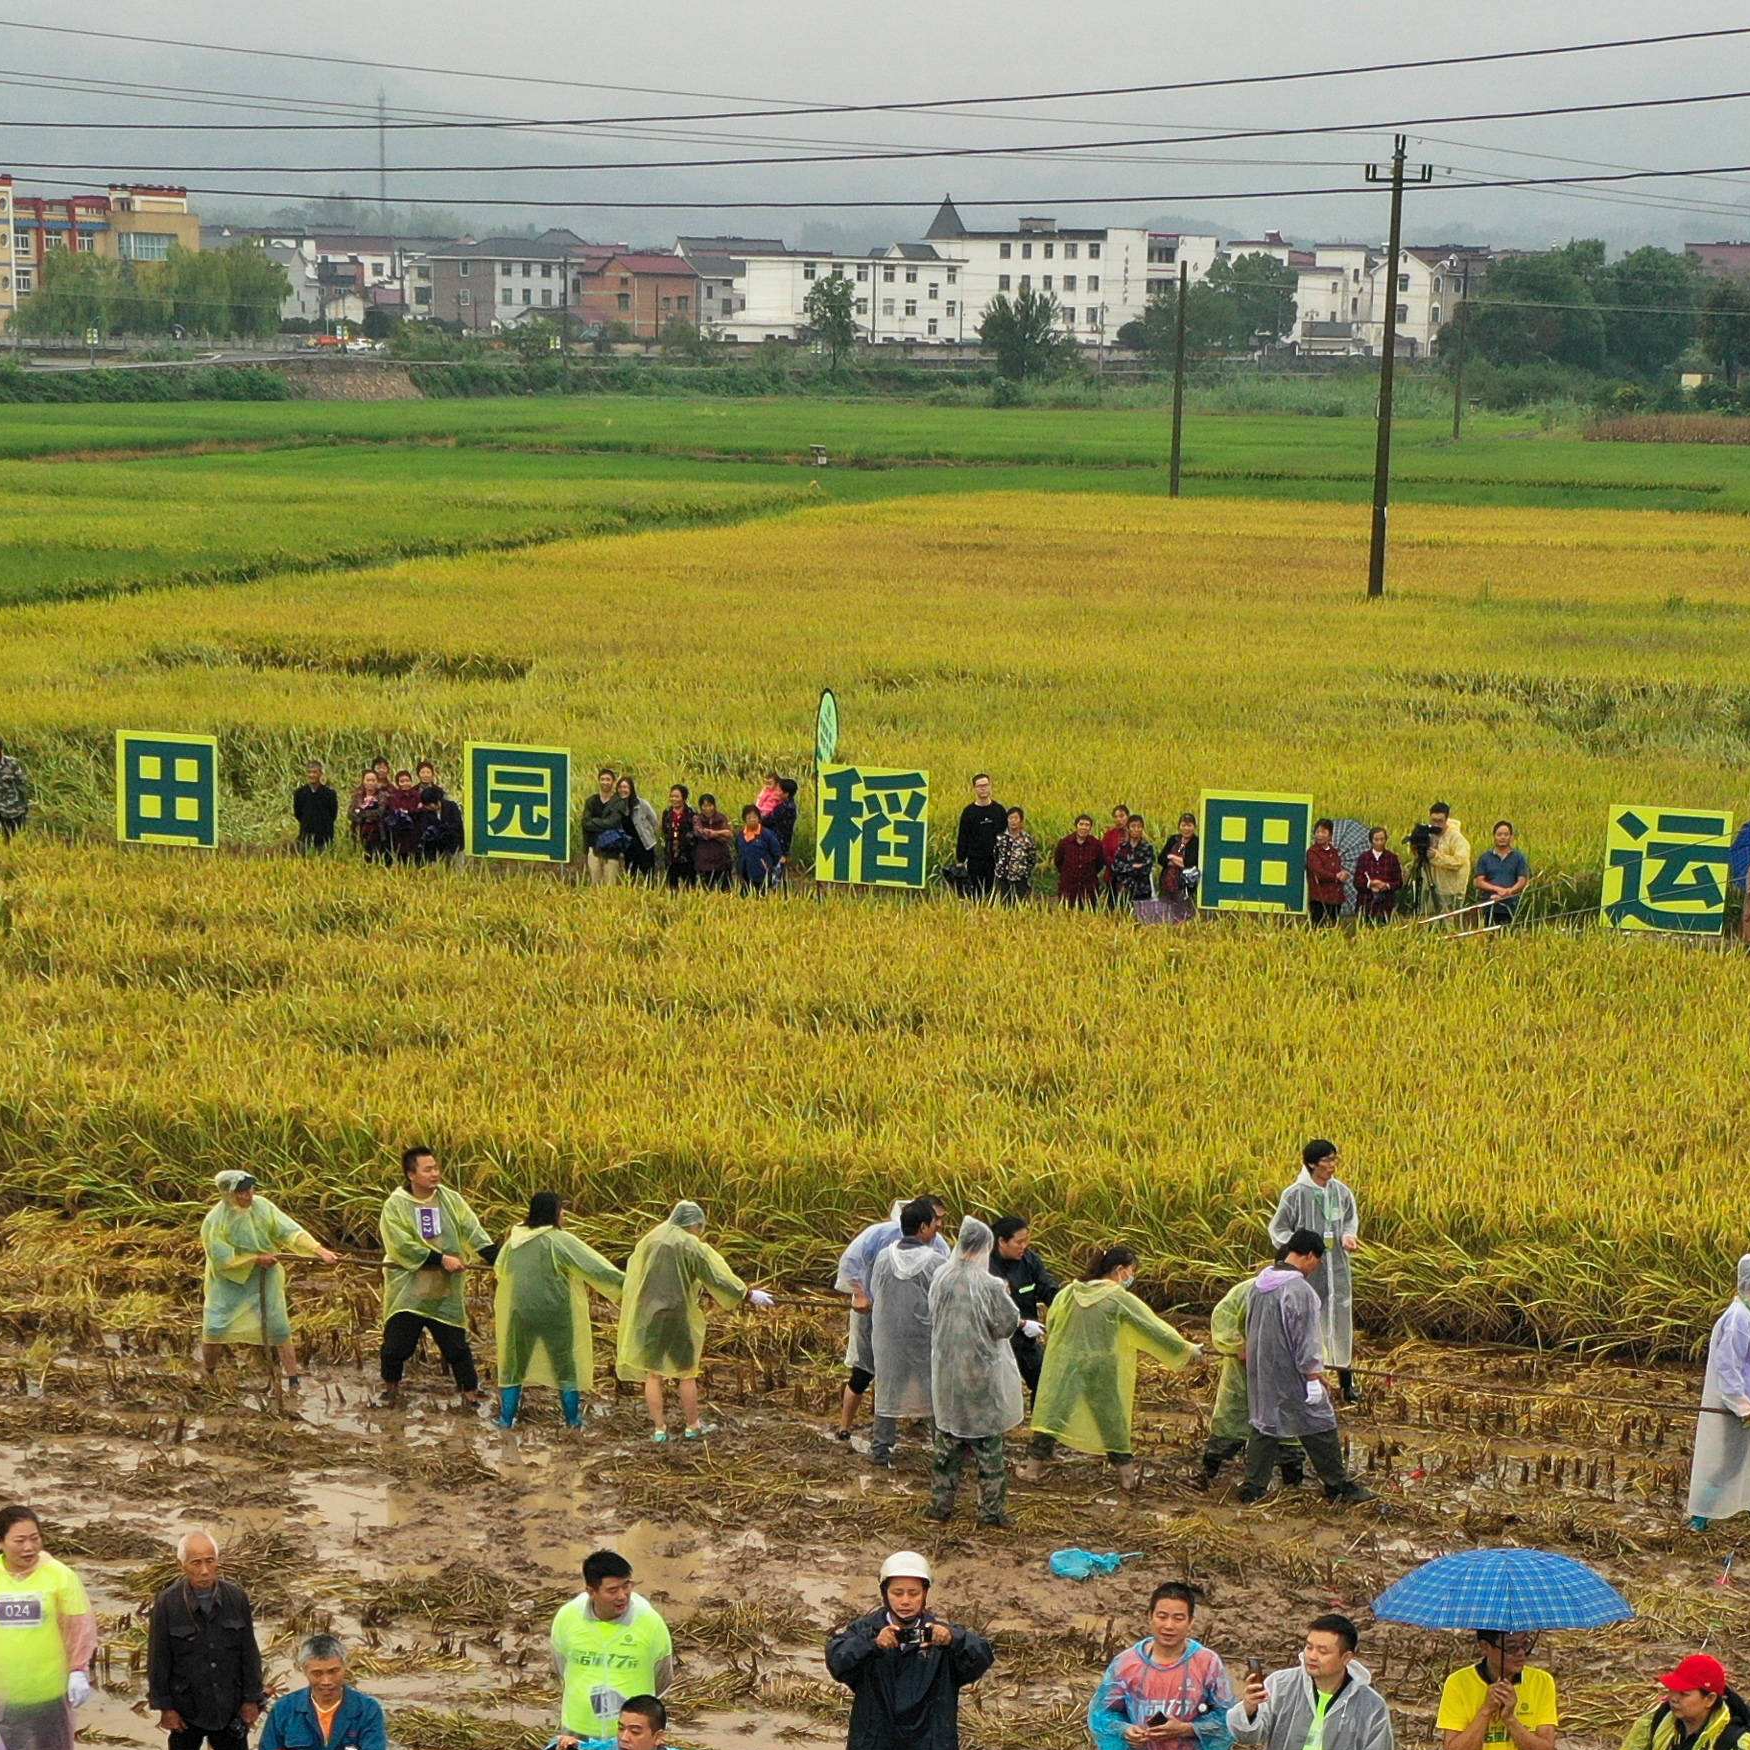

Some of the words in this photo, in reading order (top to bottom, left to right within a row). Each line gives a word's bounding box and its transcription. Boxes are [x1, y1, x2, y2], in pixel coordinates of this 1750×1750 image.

[124, 739, 214, 843] 田
[476, 750, 569, 859] 园
[822, 768, 926, 884] 稻
[1205, 800, 1308, 909] 田
[1604, 811, 1732, 929] 运
[4, 1603, 30, 1618] 024
